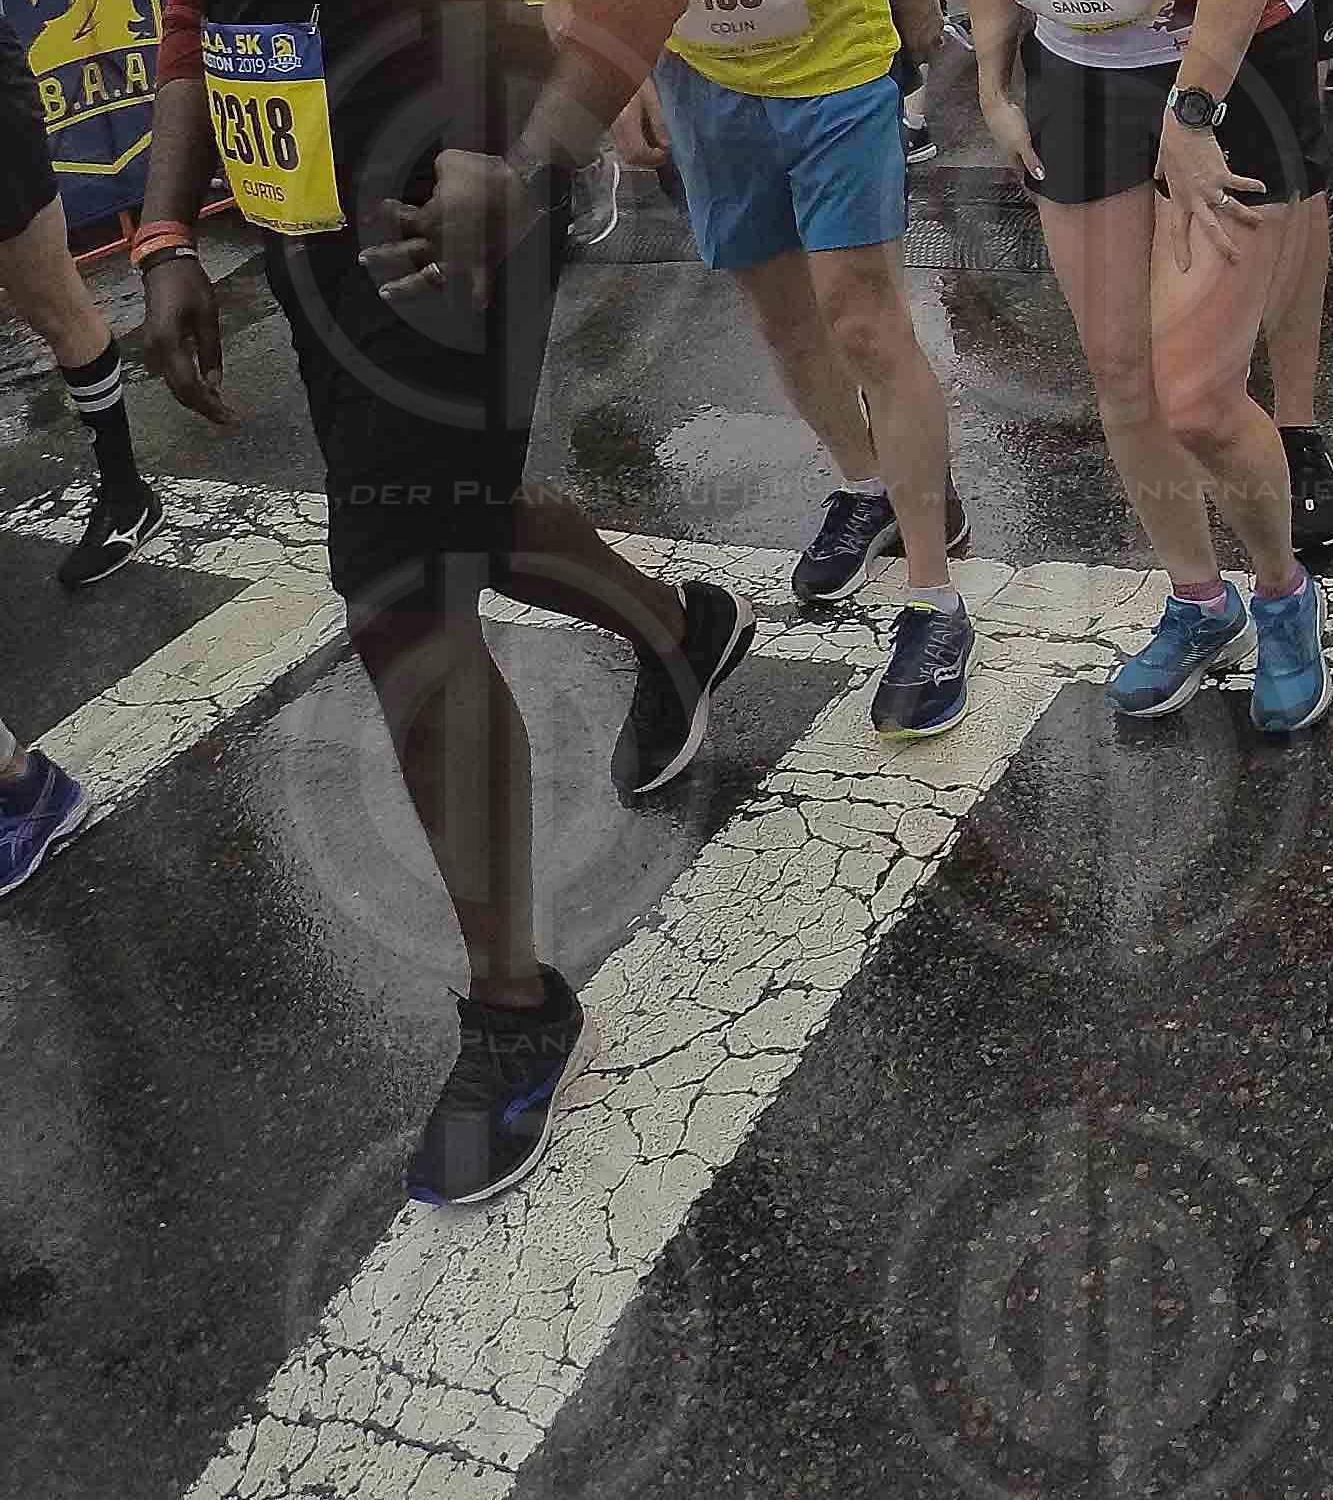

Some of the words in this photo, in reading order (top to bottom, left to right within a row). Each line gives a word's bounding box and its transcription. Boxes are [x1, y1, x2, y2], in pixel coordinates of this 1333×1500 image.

[1052, 0, 1114, 15] SANDRA
[711, 20, 756, 35] COLIN
[236, 34, 263, 55] 5K
[236, 57, 266, 73] 2019
[212, 90, 299, 172] 2318
[243, 179, 285, 202] CURTIS
